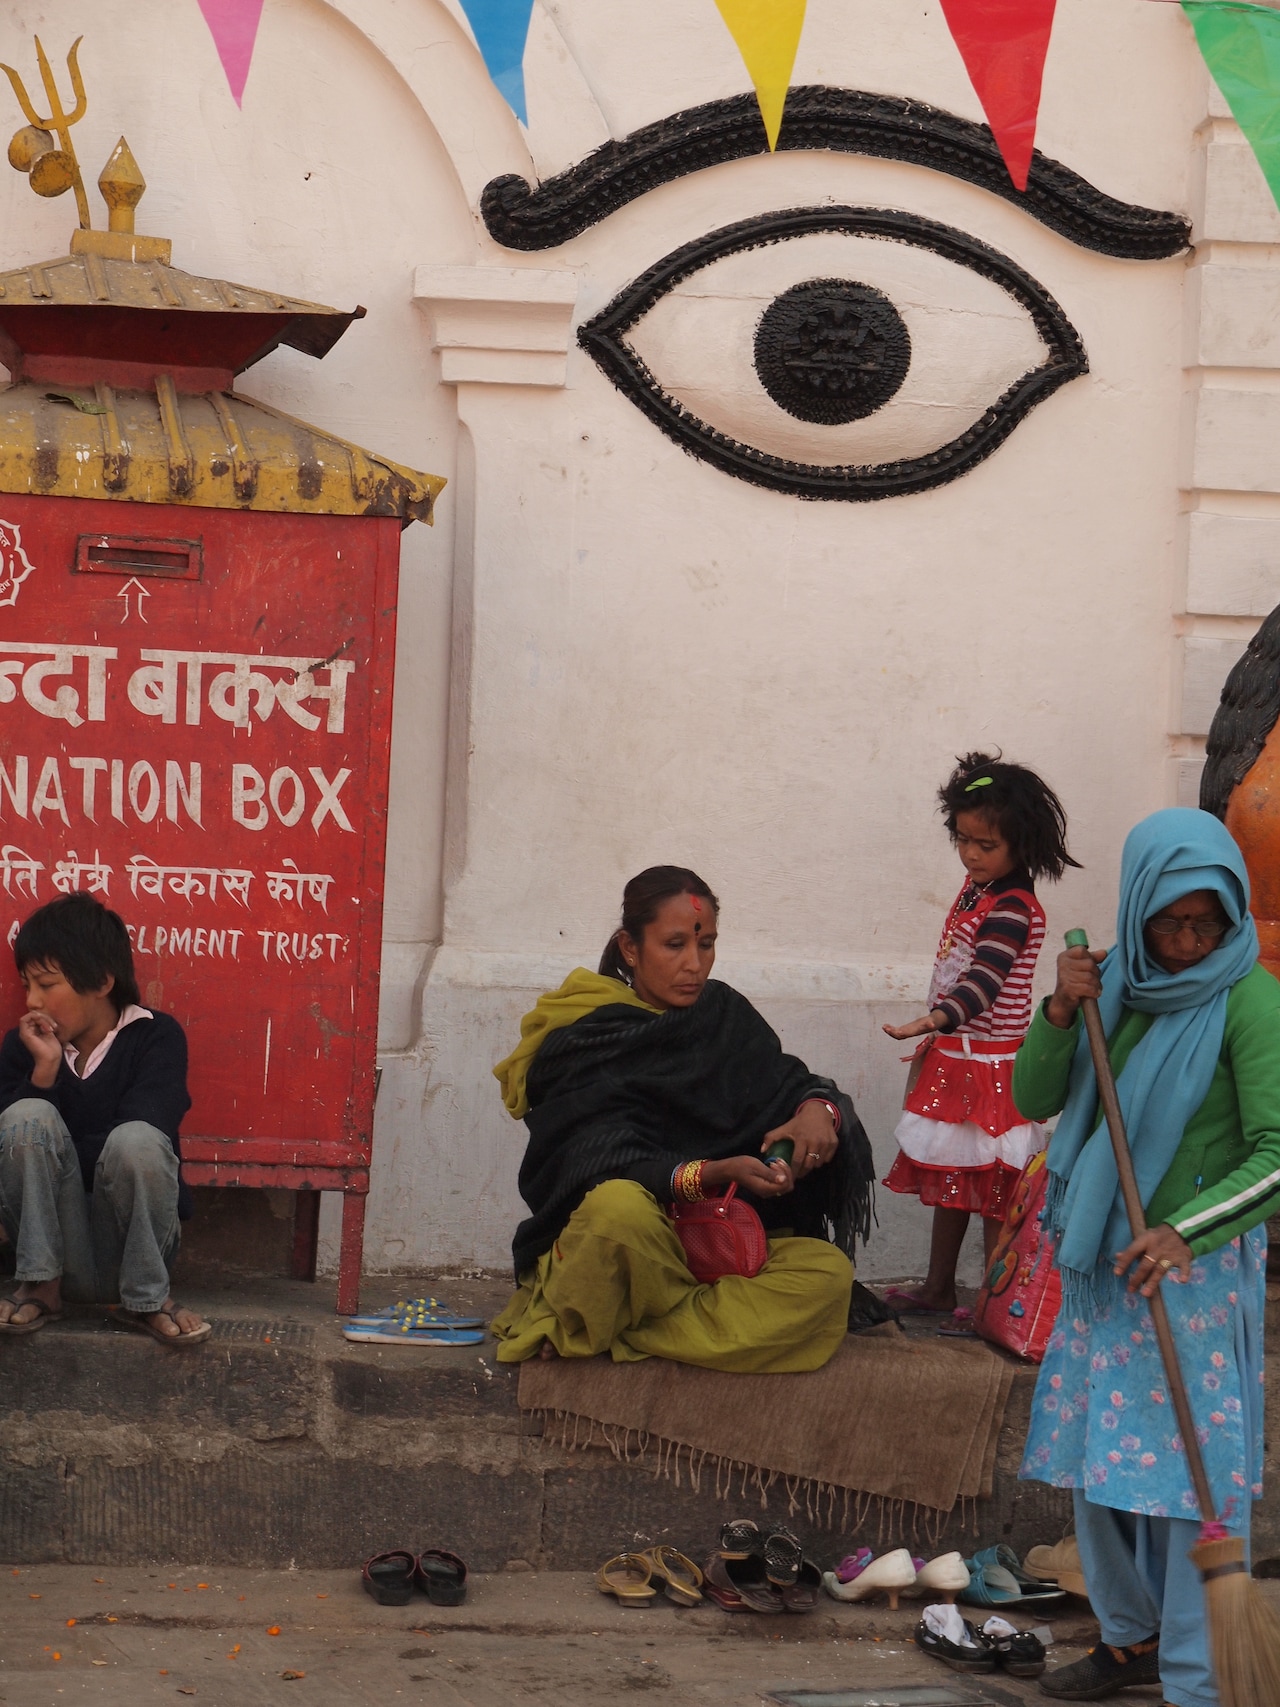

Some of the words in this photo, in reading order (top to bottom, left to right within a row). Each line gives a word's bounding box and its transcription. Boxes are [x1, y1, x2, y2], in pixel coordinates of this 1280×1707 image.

[232, 763, 357, 838] BOX
[0, 845, 46, 900] ति
[125, 854, 256, 911] विकास
[265, 858, 335, 915] कोष
[257, 931, 343, 964] TRUST
